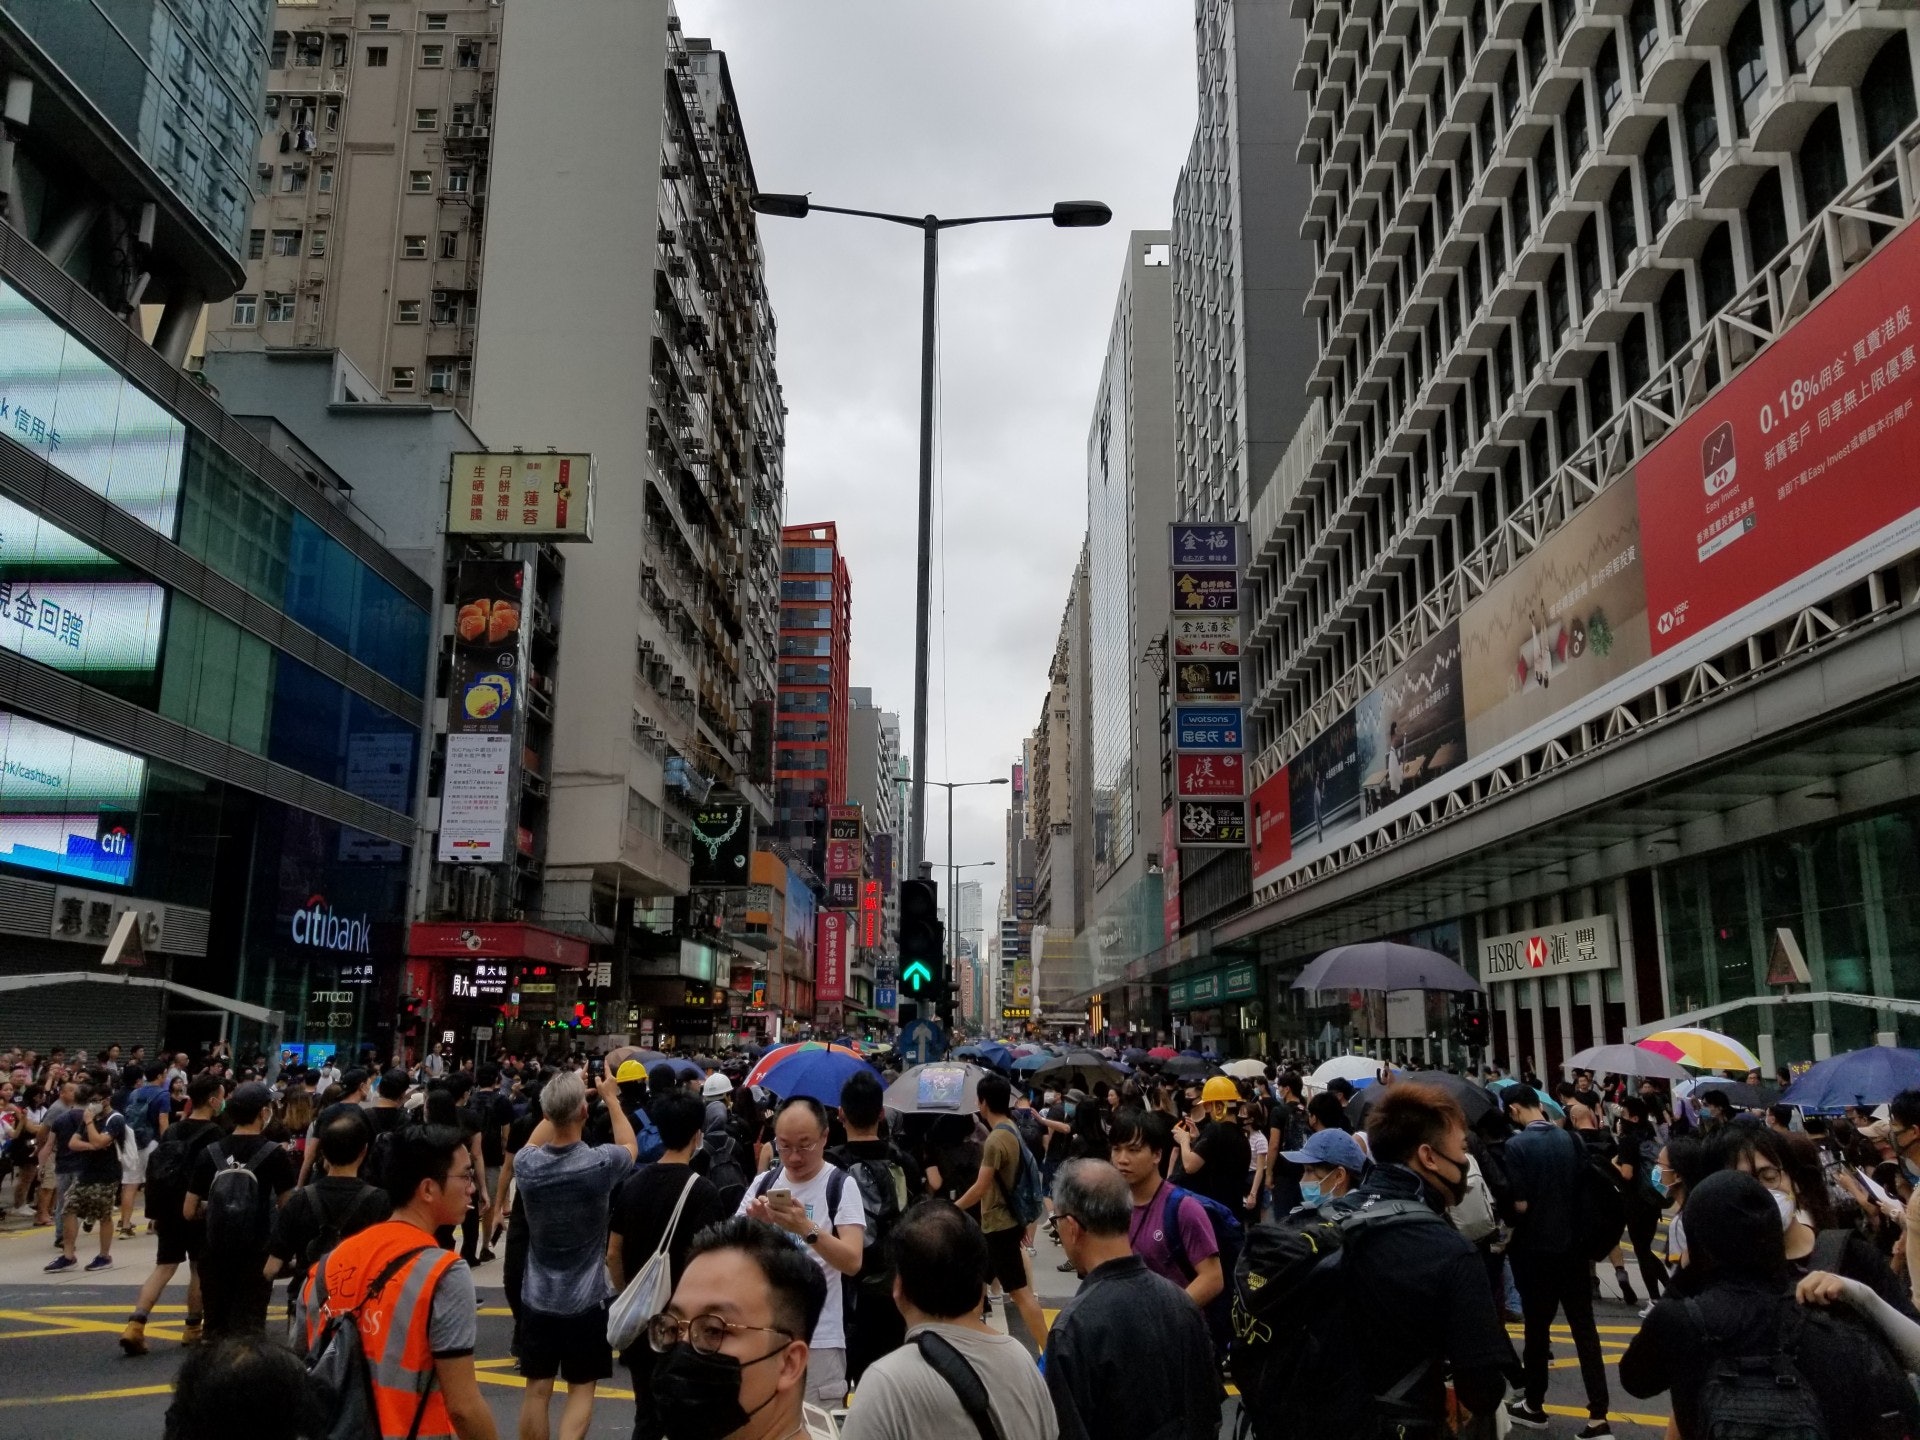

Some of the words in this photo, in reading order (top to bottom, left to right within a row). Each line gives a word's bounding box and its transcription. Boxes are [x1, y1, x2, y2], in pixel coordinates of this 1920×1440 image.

[1853, 305, 1913, 367] 買賣港股
[1817, 344, 1917, 433] 同享無上限優惠
[14, 405, 61, 452] 信用卡
[1706, 499, 1720, 514] Easy
[1721, 484, 1740, 503] Invest
[1208, 596, 1231, 608] 3/F
[1674, 600, 1689, 616] HSBC
[1215, 670, 1237, 686] 1/F
[1182, 730, 1219, 743] 屈臣氏
[101, 830, 126, 856] citi
[833, 828, 857, 838] 10/F
[1219, 827, 1244, 839] 5/F
[833, 884, 854, 896] 周生生
[292, 904, 371, 954] citibank
[1487, 940, 1524, 974] HSBC
